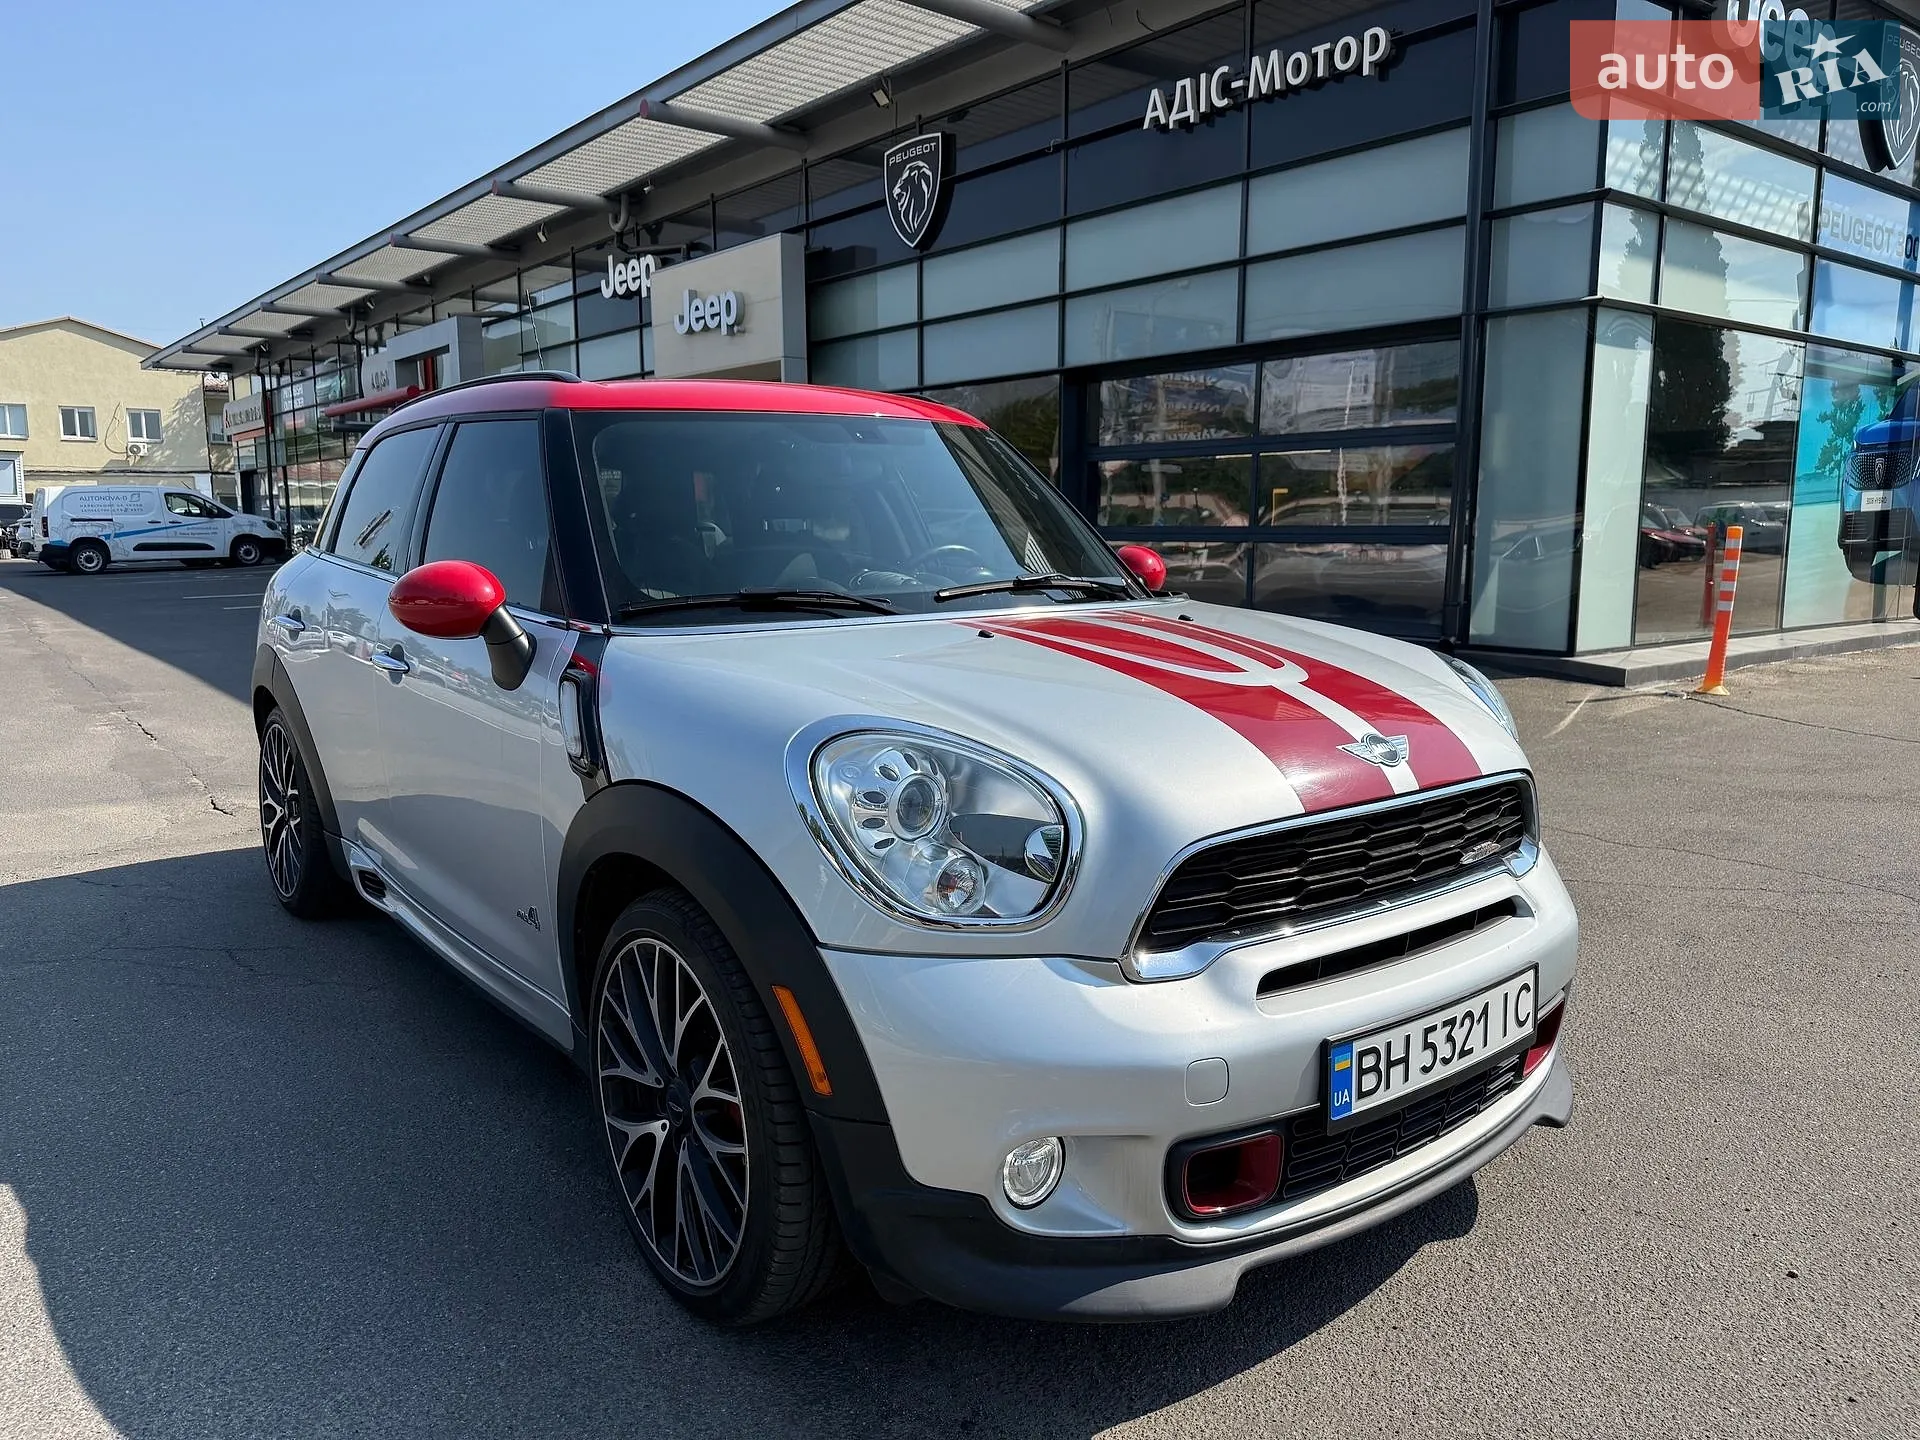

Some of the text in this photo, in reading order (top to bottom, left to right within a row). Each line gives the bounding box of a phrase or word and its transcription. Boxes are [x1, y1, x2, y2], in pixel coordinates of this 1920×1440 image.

[1143, 26, 1391, 130] АДІС-Мотор
[889, 142, 936, 167] PEUGEOT
[1820, 206, 1893, 253] PEUGEOT
[601, 254, 655, 299] Jeep
[673, 288, 738, 336] Jeep
[1420, 1001, 1490, 1075] 5321
[1503, 982, 1532, 1038] IC
[1334, 1088, 1350, 1107] UA
